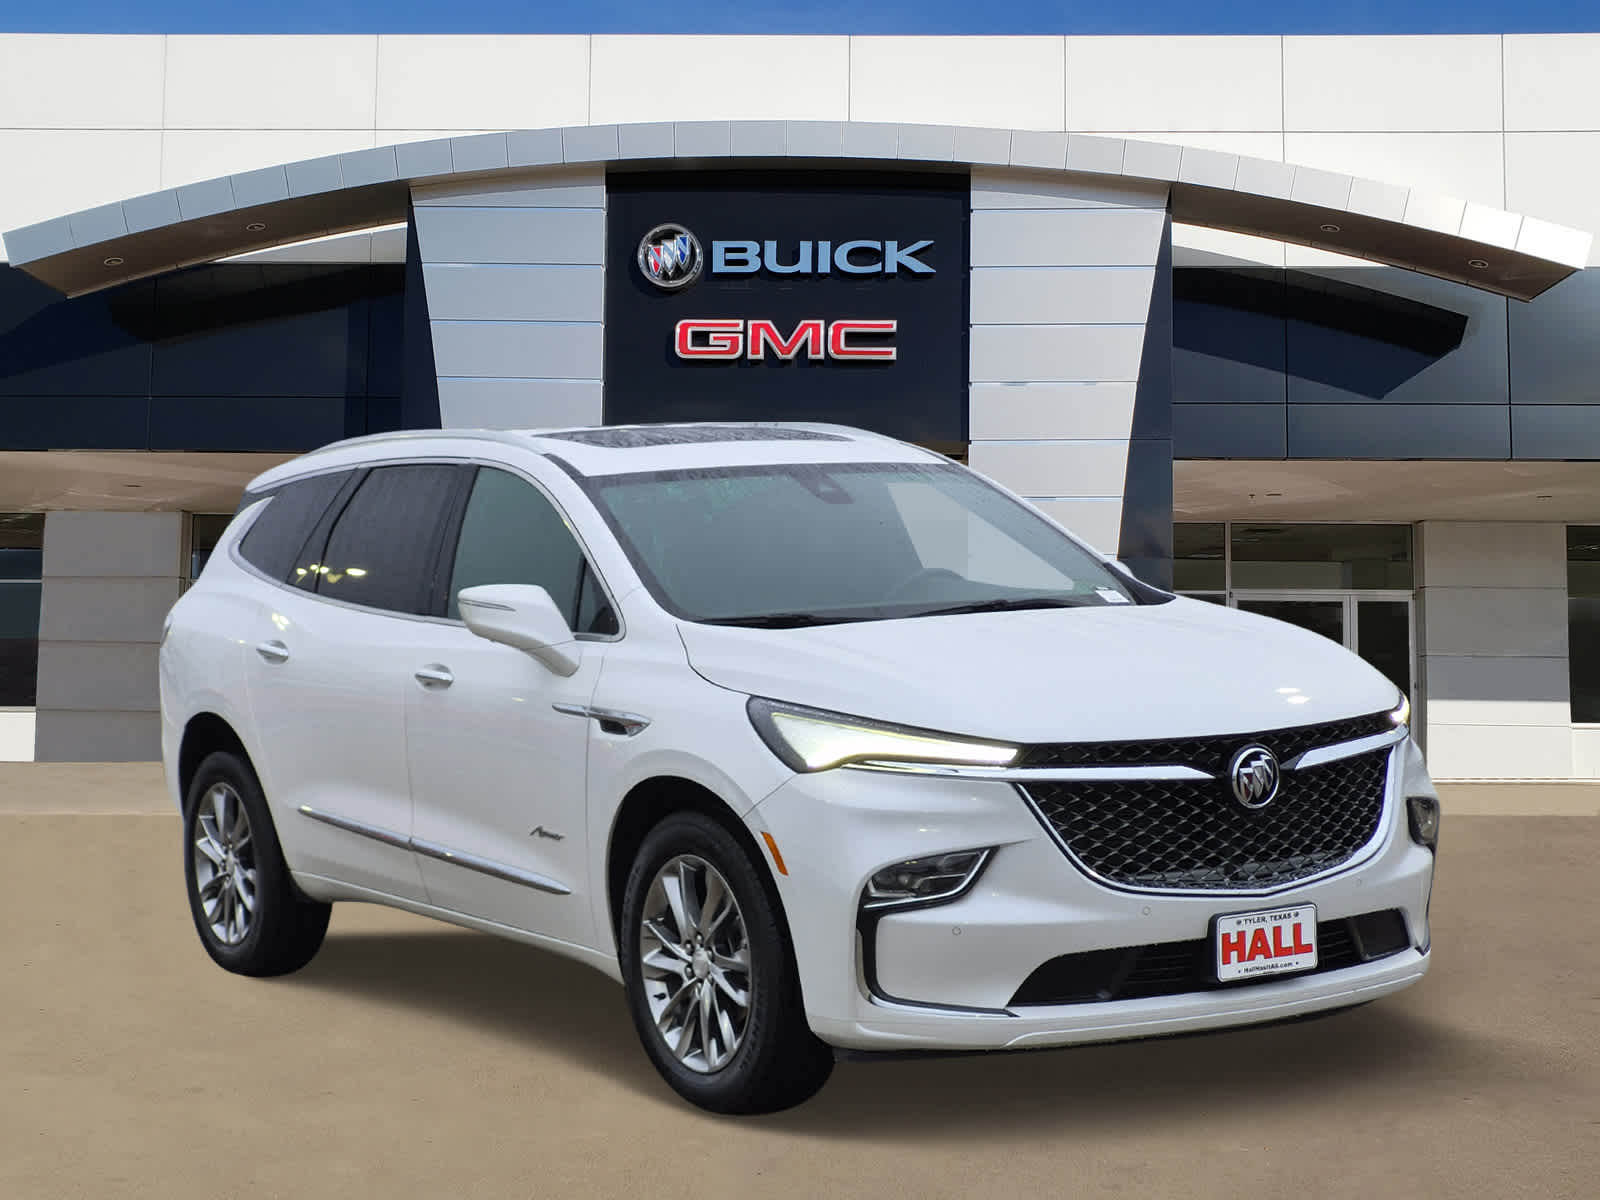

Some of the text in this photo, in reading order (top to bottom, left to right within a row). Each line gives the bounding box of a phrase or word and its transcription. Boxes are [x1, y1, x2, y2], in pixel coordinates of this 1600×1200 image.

[712, 240, 936, 273] BUICK
[675, 319, 897, 360] GMC
[1244, 913, 1292, 925] TYLER, TEXAS
[1221, 923, 1313, 966] HALL
